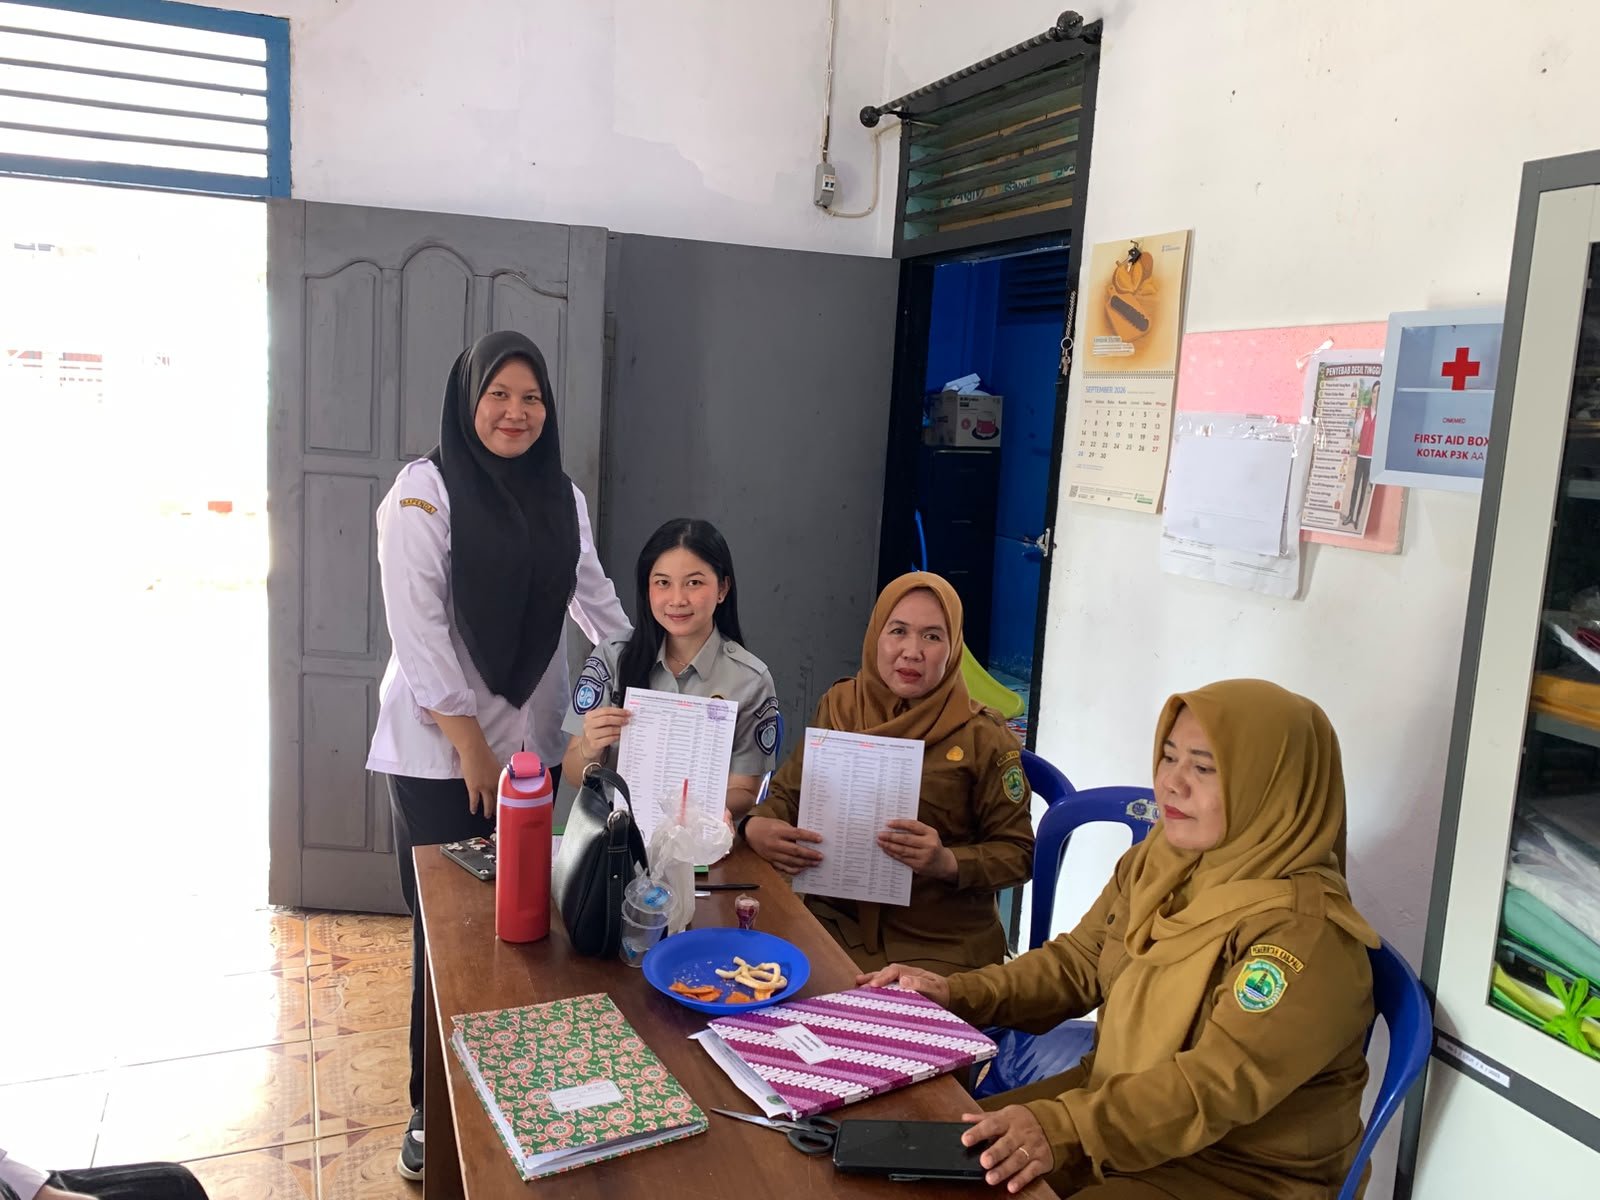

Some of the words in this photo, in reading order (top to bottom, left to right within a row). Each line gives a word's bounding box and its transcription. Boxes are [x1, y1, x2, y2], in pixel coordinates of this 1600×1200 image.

[1414, 434, 1443, 444] FIRST
[1445, 436, 1464, 445] AID
[1417, 448, 1448, 458] KOTAK
[1450, 450, 1469, 460] P3K
